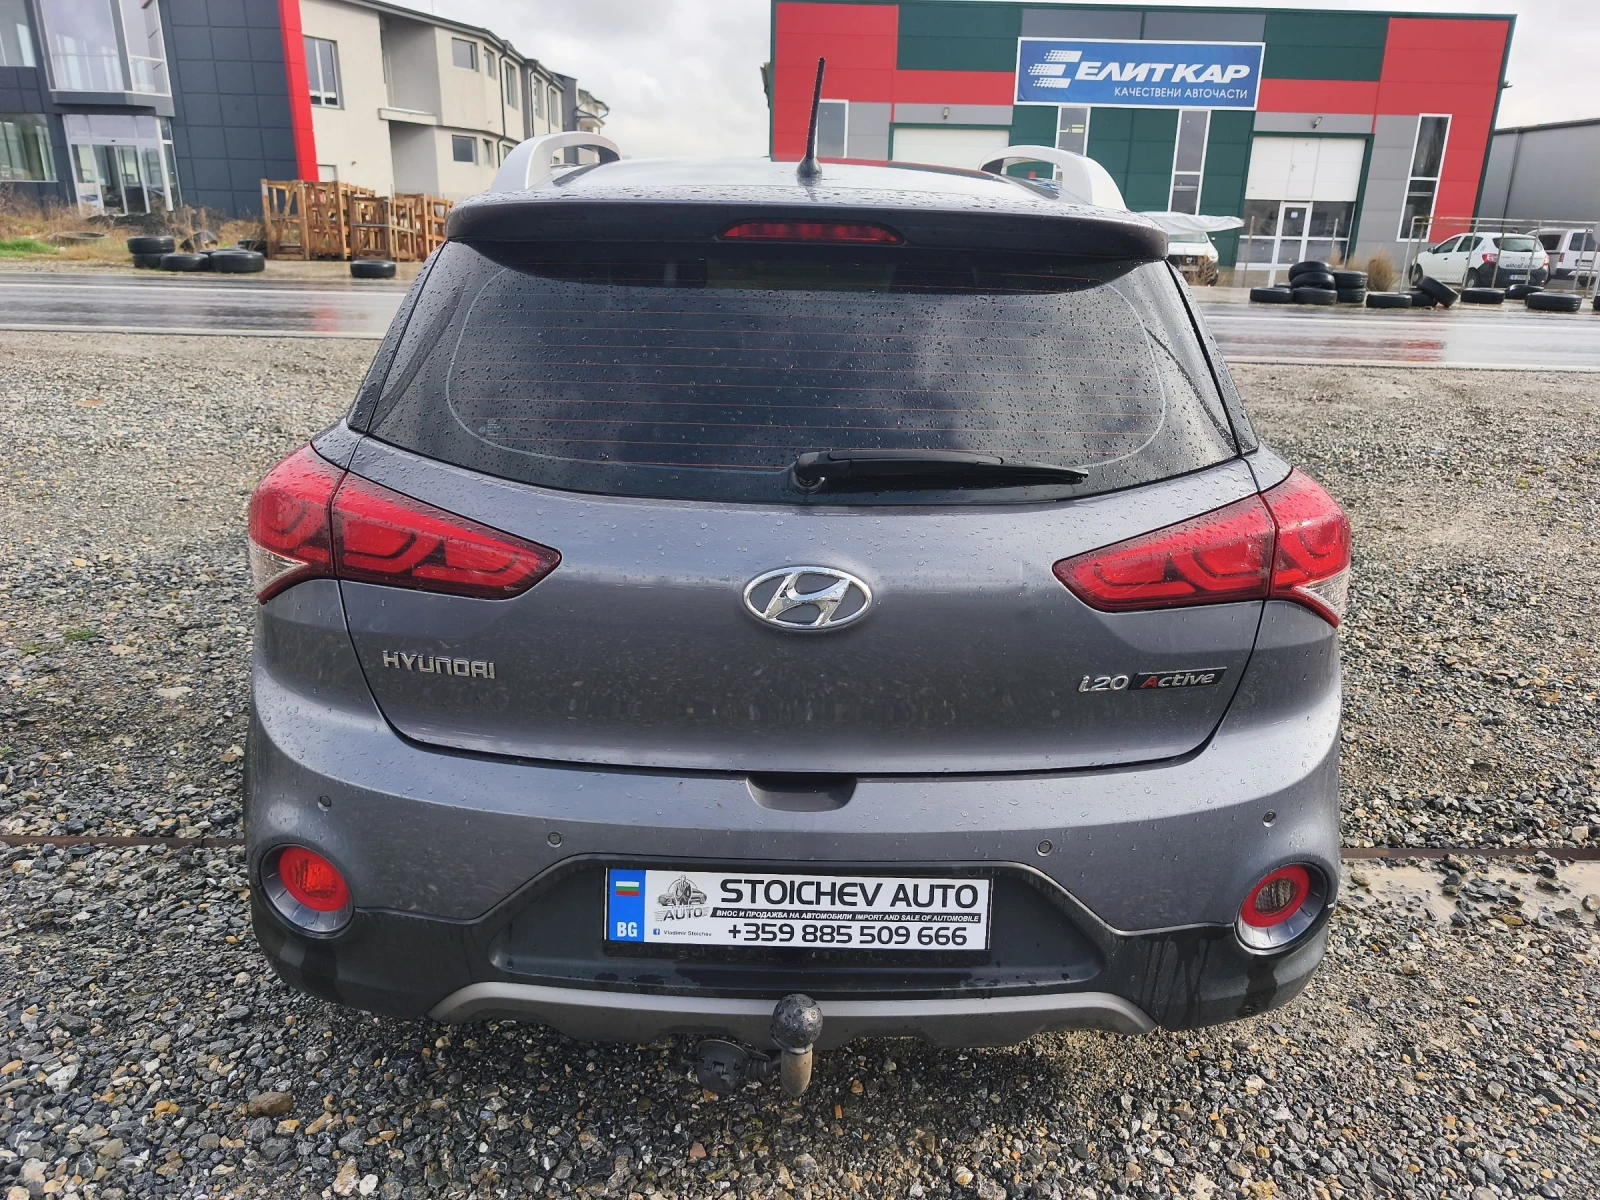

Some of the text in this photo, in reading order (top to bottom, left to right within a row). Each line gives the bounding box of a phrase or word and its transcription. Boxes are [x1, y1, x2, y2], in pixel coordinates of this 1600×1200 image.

[1114, 86, 1248, 99] КАЧЕСТВЕНИ АВТОЧАСТИ
[382, 650, 496, 679] HYUNDAI
[1077, 672, 1215, 693] i20 Active
[720, 878, 979, 909] STOICHEV AUTO
[663, 907, 703, 921] AUTO
[716, 909, 737, 917] ВНОС
[739, 910, 745, 918] И
[745, 910, 788, 919] ПРОДАЖБА
[788, 911, 800, 919] НА
[800, 912, 853, 920] АВТОМОБИЛИ
[855, 913, 883, 921] IMPORT
[616, 921, 638, 938] BG
[728, 922, 968, 946] +359 885 509 666
